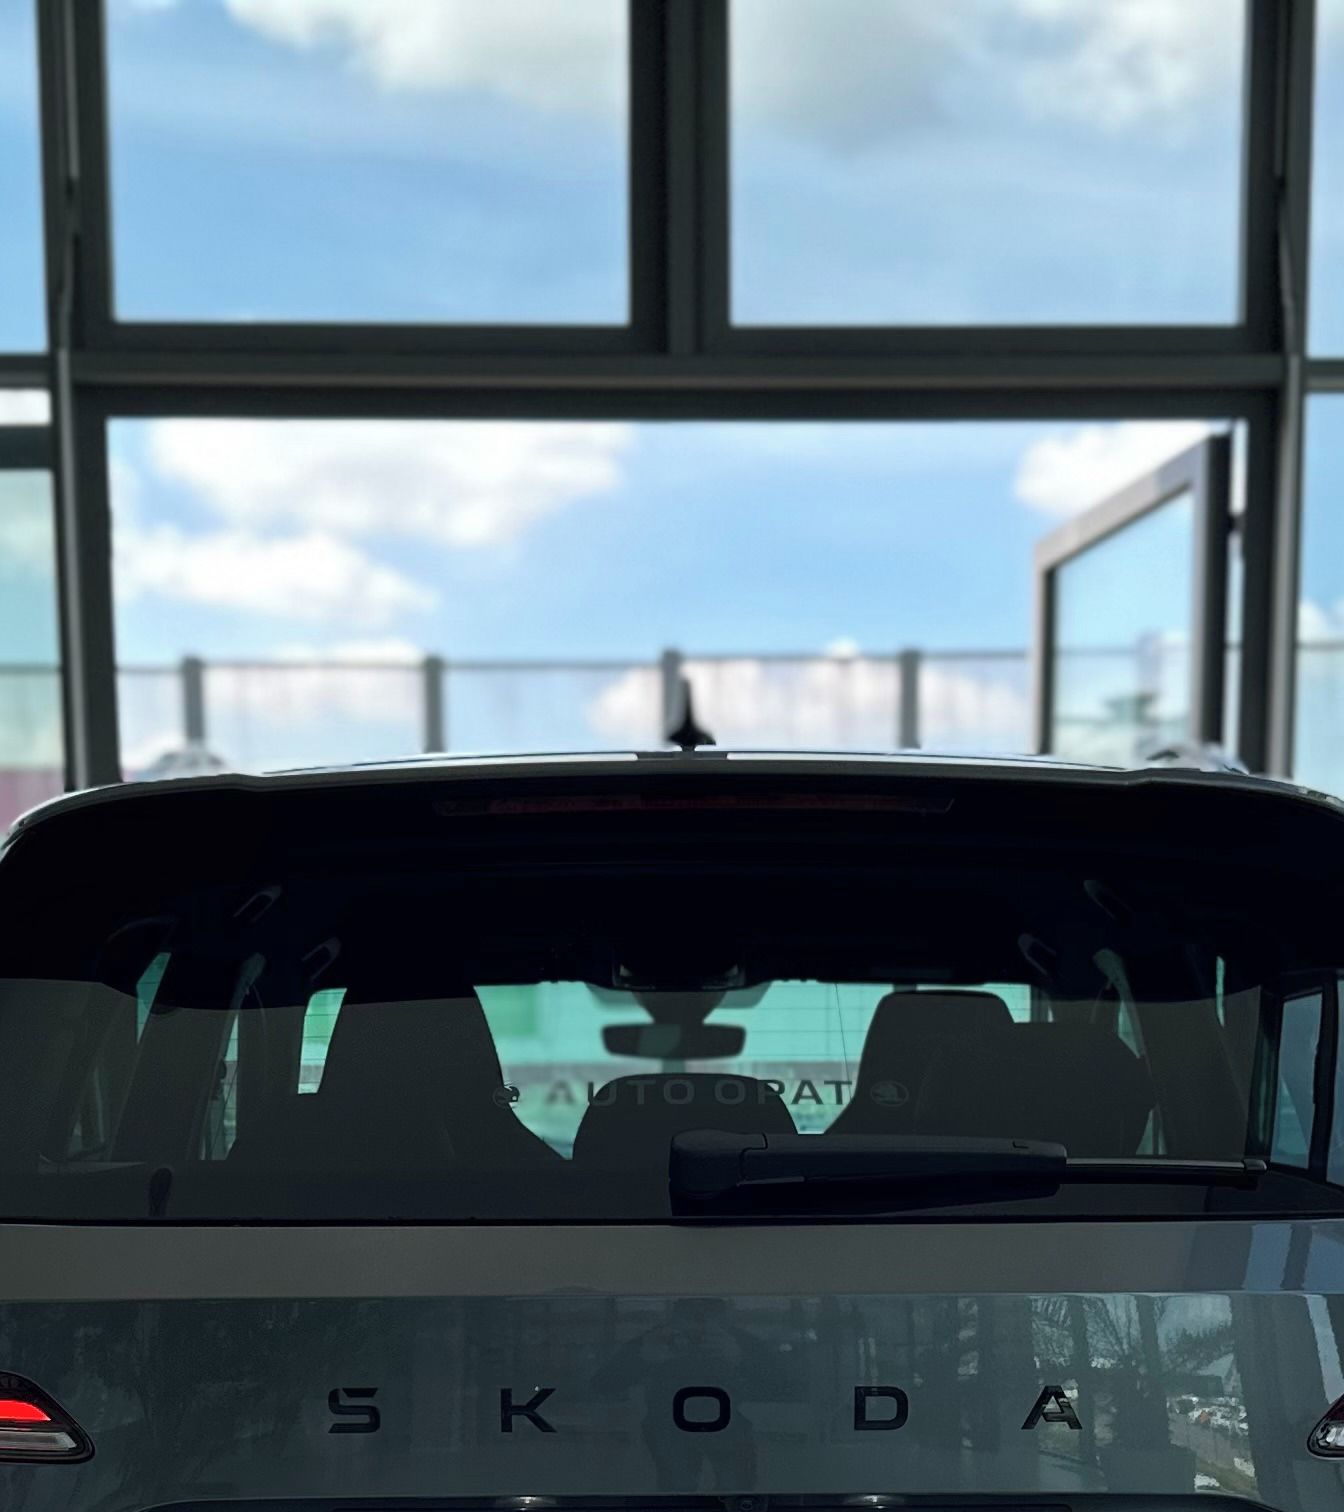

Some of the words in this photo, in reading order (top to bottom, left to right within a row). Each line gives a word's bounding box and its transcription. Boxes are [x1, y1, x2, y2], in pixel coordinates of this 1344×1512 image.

[545, 1079, 695, 1106] AUTO
[714, 1079, 853, 1106] OPAT
[327, 1385, 1083, 1433] SKODA
